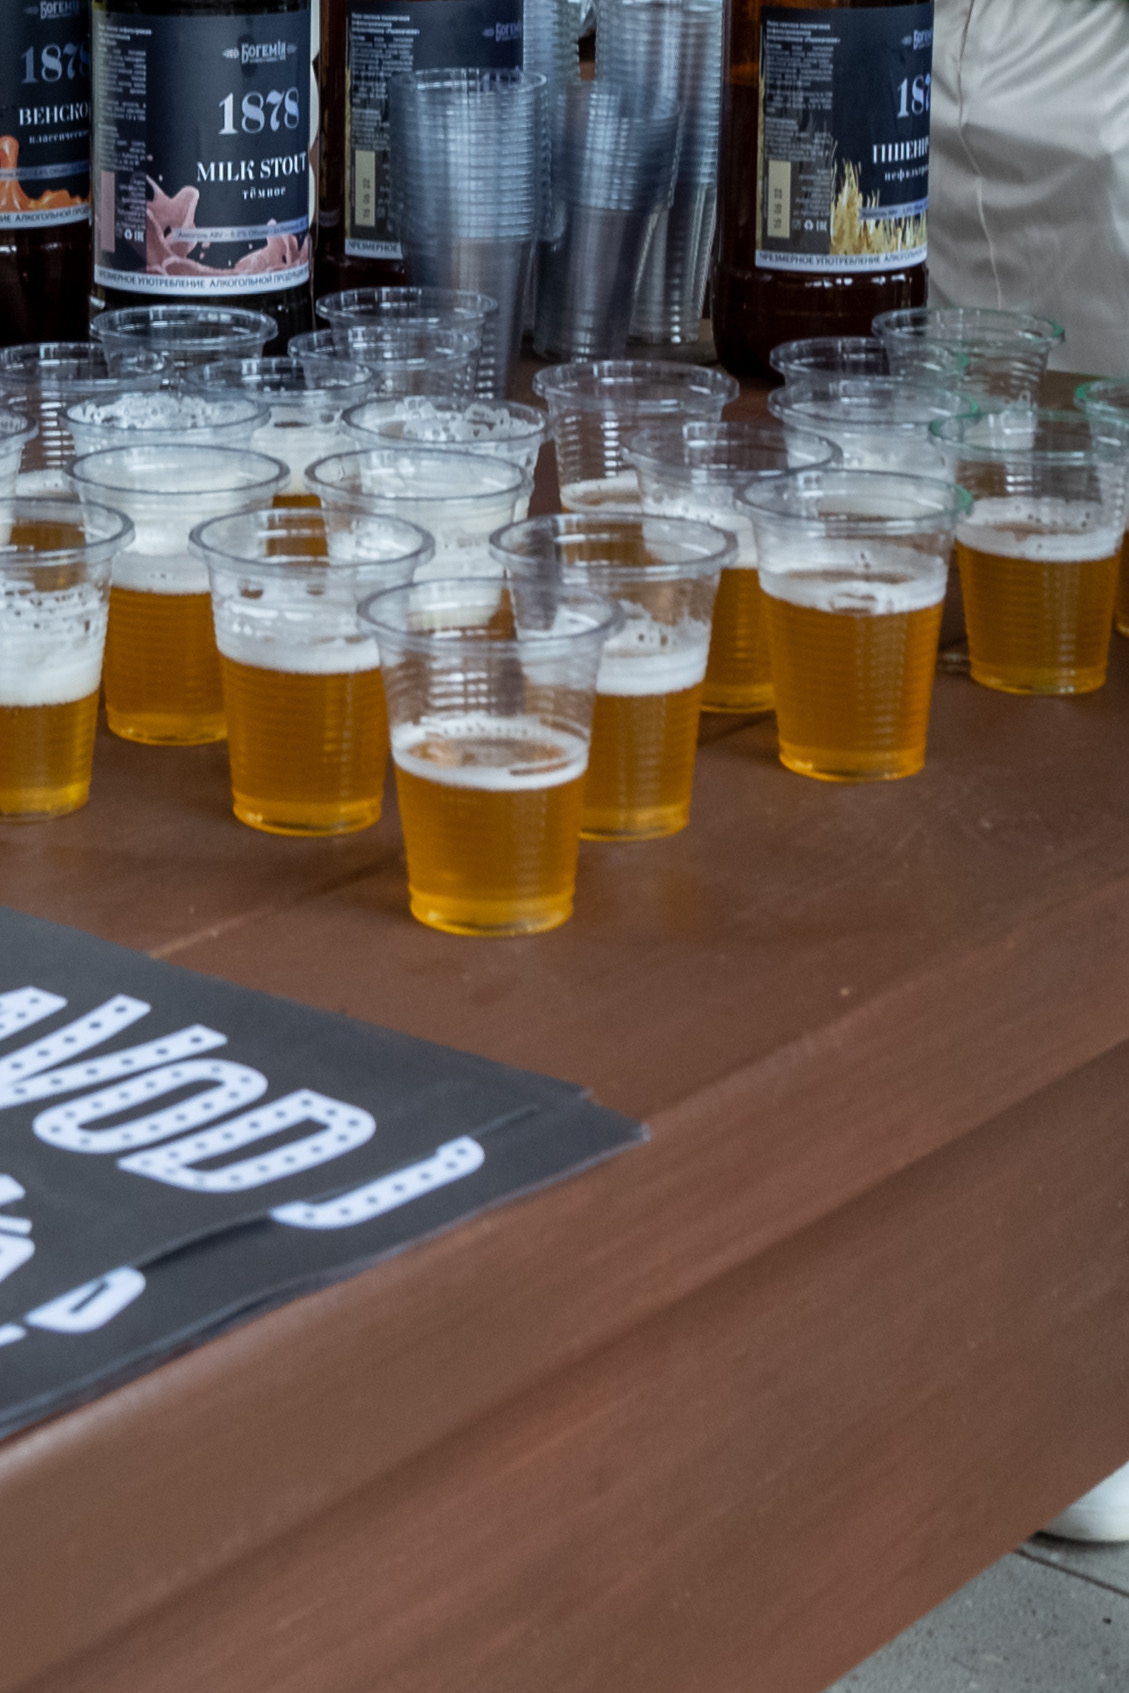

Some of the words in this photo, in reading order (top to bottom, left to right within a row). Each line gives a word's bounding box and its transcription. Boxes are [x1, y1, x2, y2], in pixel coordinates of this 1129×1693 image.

[218, 86, 300, 135] 1878
[196, 160, 255, 182] MILK
[259, 152, 307, 179] STOUT
[137, 276, 205, 290] УПОТРЕБЛЕНИЕ
